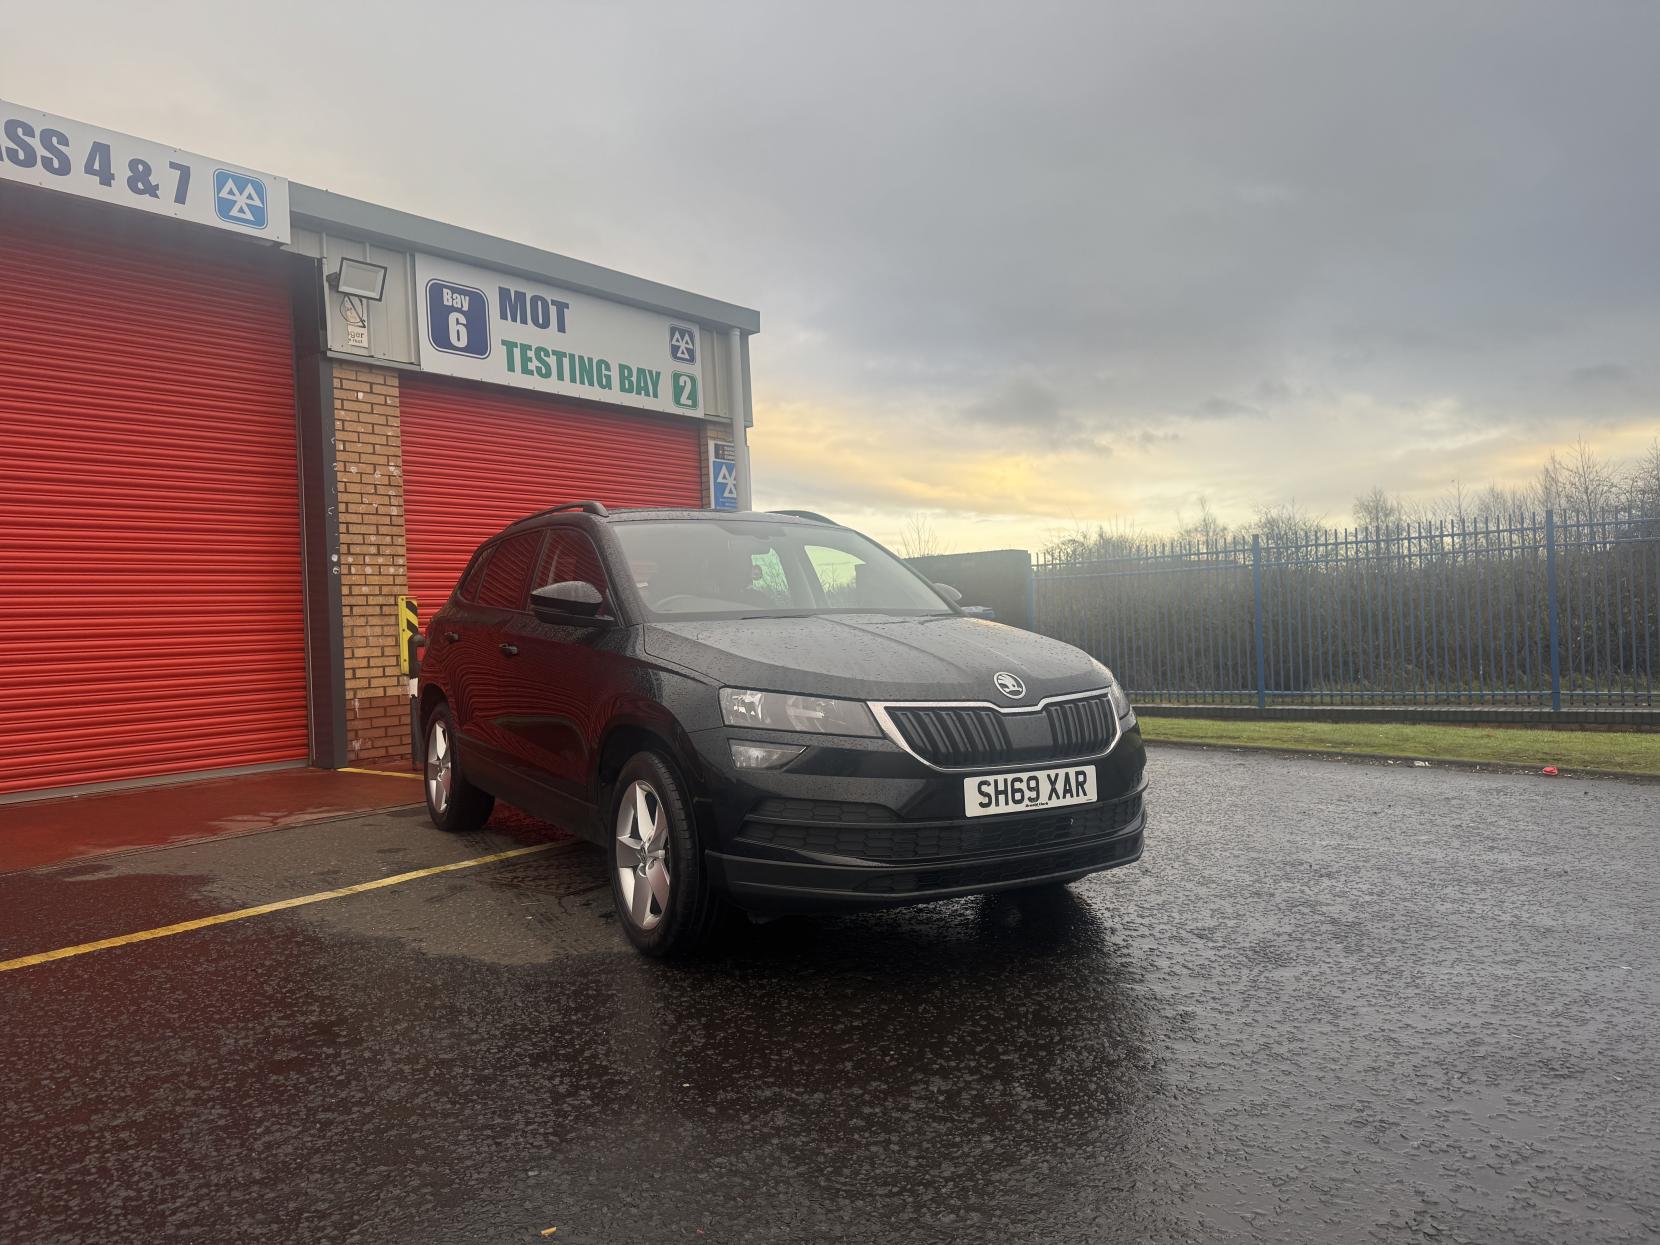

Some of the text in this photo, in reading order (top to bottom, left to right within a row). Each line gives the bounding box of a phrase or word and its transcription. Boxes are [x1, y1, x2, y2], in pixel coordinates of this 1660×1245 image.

[0, 118, 191, 205] SS 4 & 7
[442, 287, 470, 312] Bay
[498, 286, 570, 334] MOT
[448, 312, 468, 348] 6
[501, 339, 662, 399] TESTING BAY
[679, 374, 693, 406] 2
[977, 770, 1088, 809] SH69 XAR
